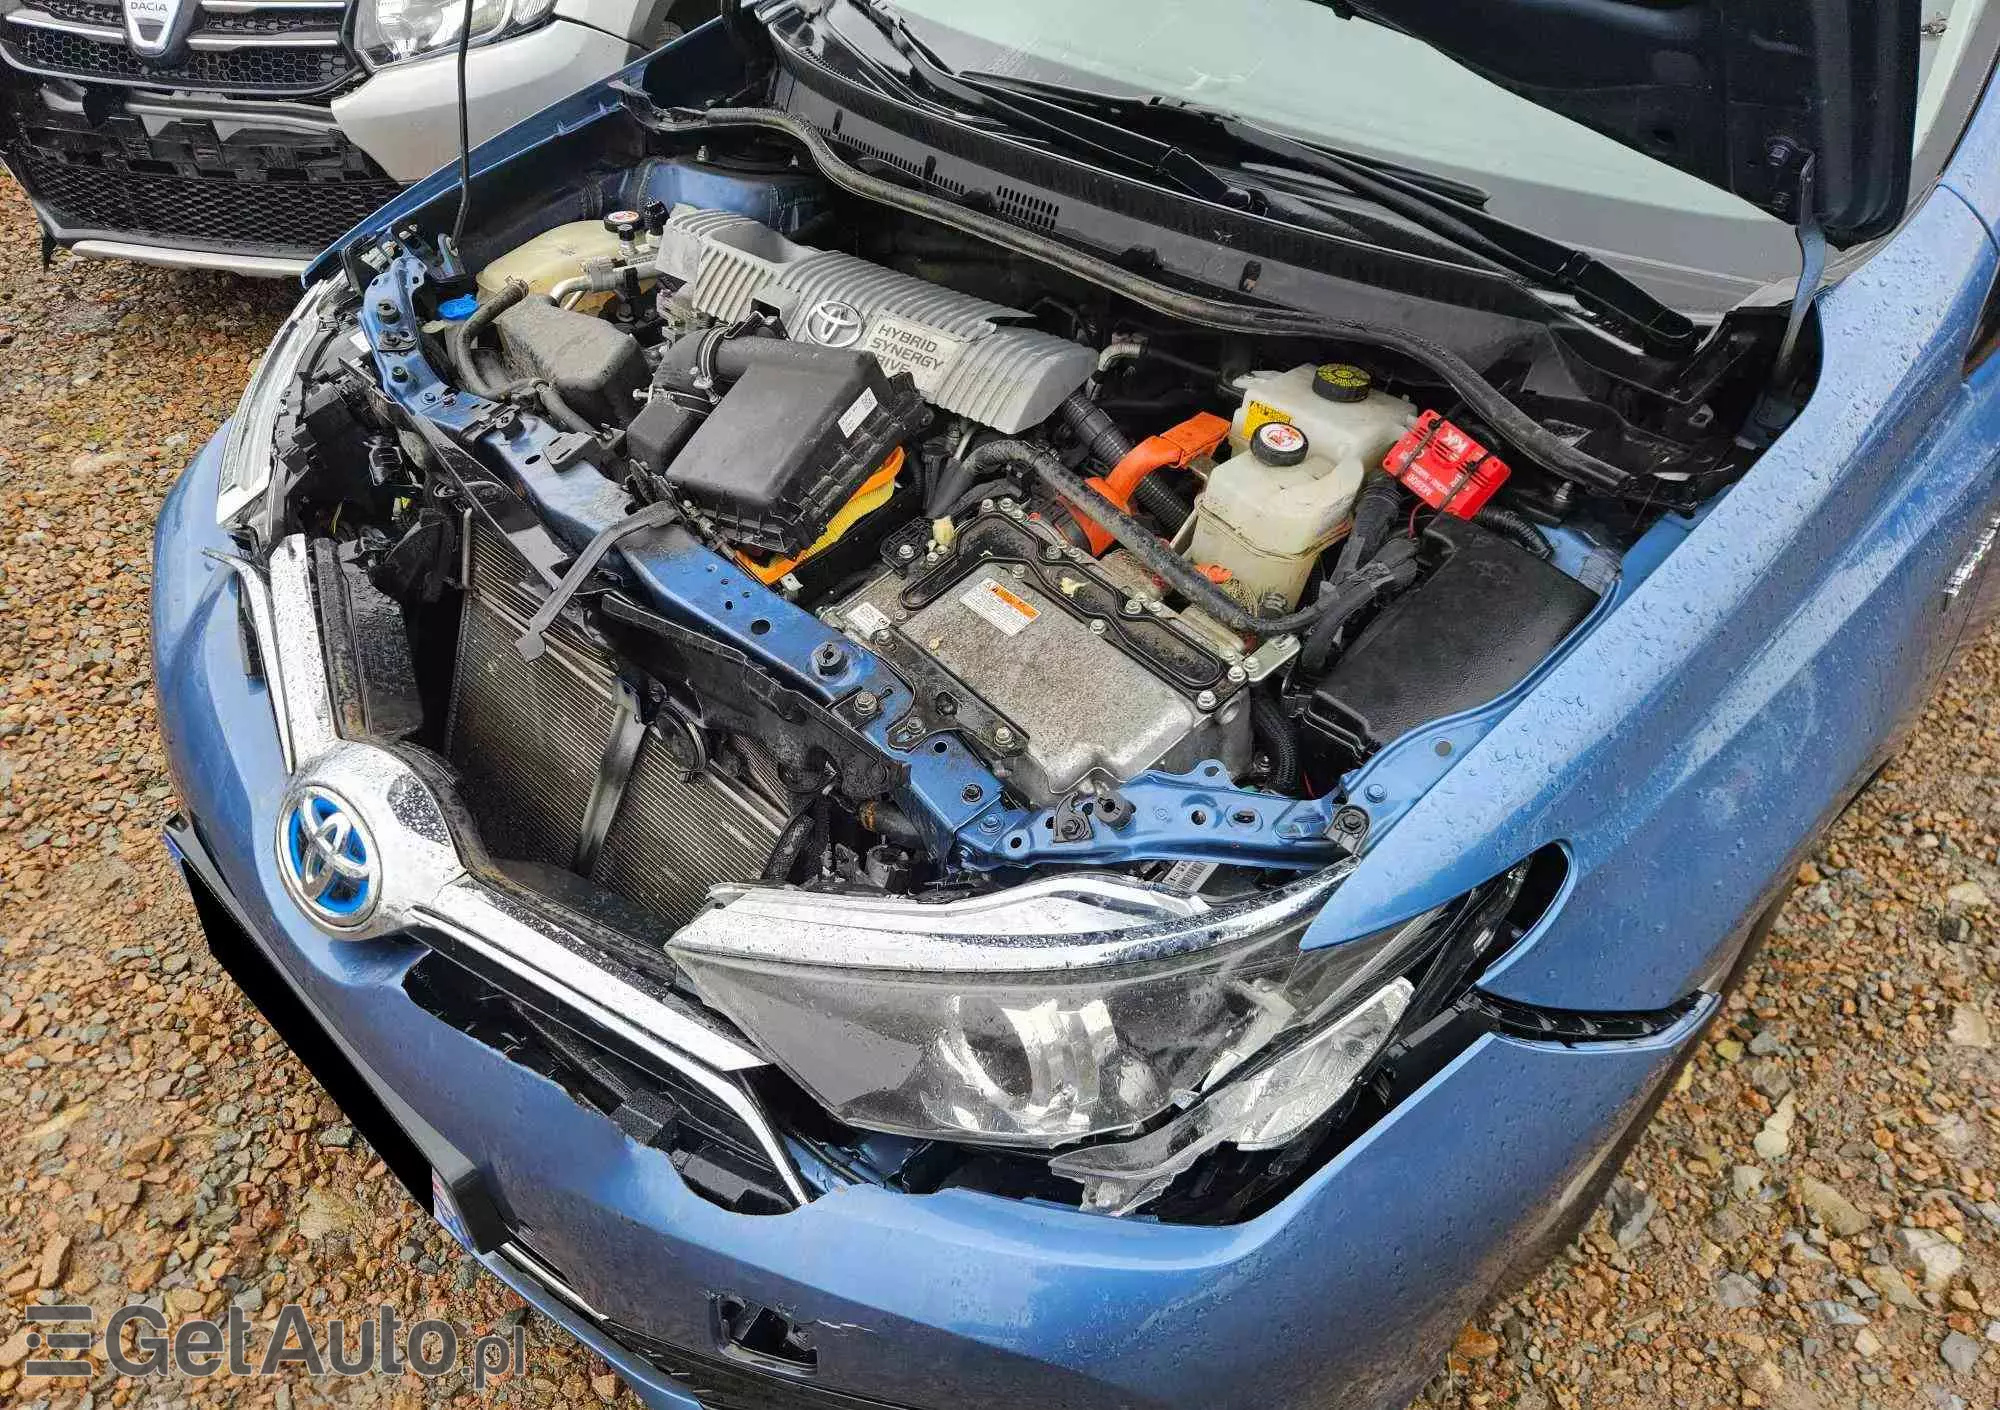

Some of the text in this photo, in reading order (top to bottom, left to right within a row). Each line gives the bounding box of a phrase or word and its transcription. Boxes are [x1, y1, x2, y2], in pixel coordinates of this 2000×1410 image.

[130, 1, 168, 11] DACIA
[878, 323, 938, 353] HYBRID
[870, 336, 944, 370] SYNERGY
[877, 354, 911, 371] RIVE
